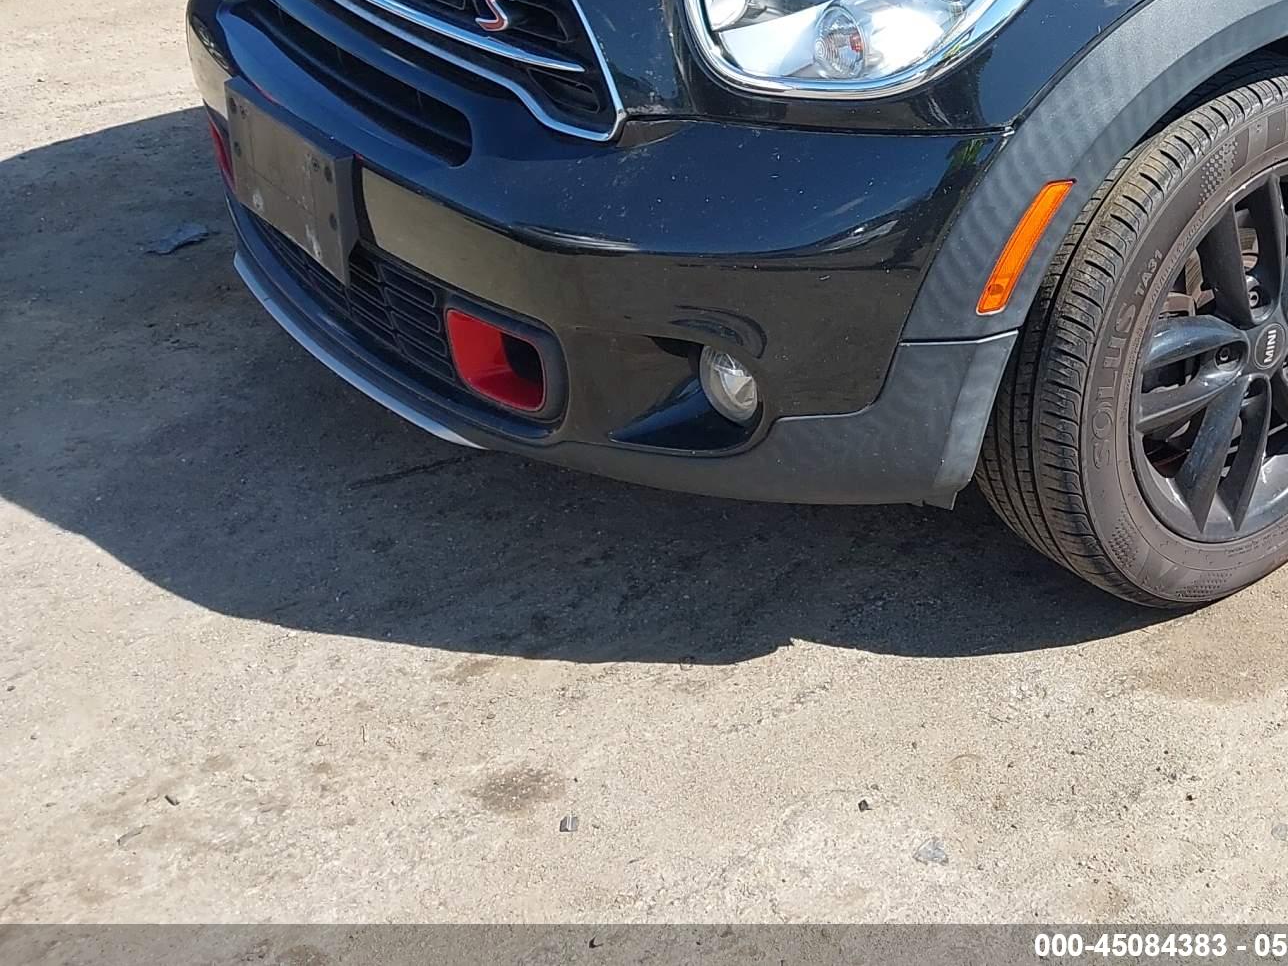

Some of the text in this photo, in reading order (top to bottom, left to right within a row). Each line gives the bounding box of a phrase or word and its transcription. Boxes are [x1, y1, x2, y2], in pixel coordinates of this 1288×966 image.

[1092, 302, 1136, 470] SOLUS
[1135, 249, 1164, 298] TA31
[1263, 329, 1278, 364] MINI
